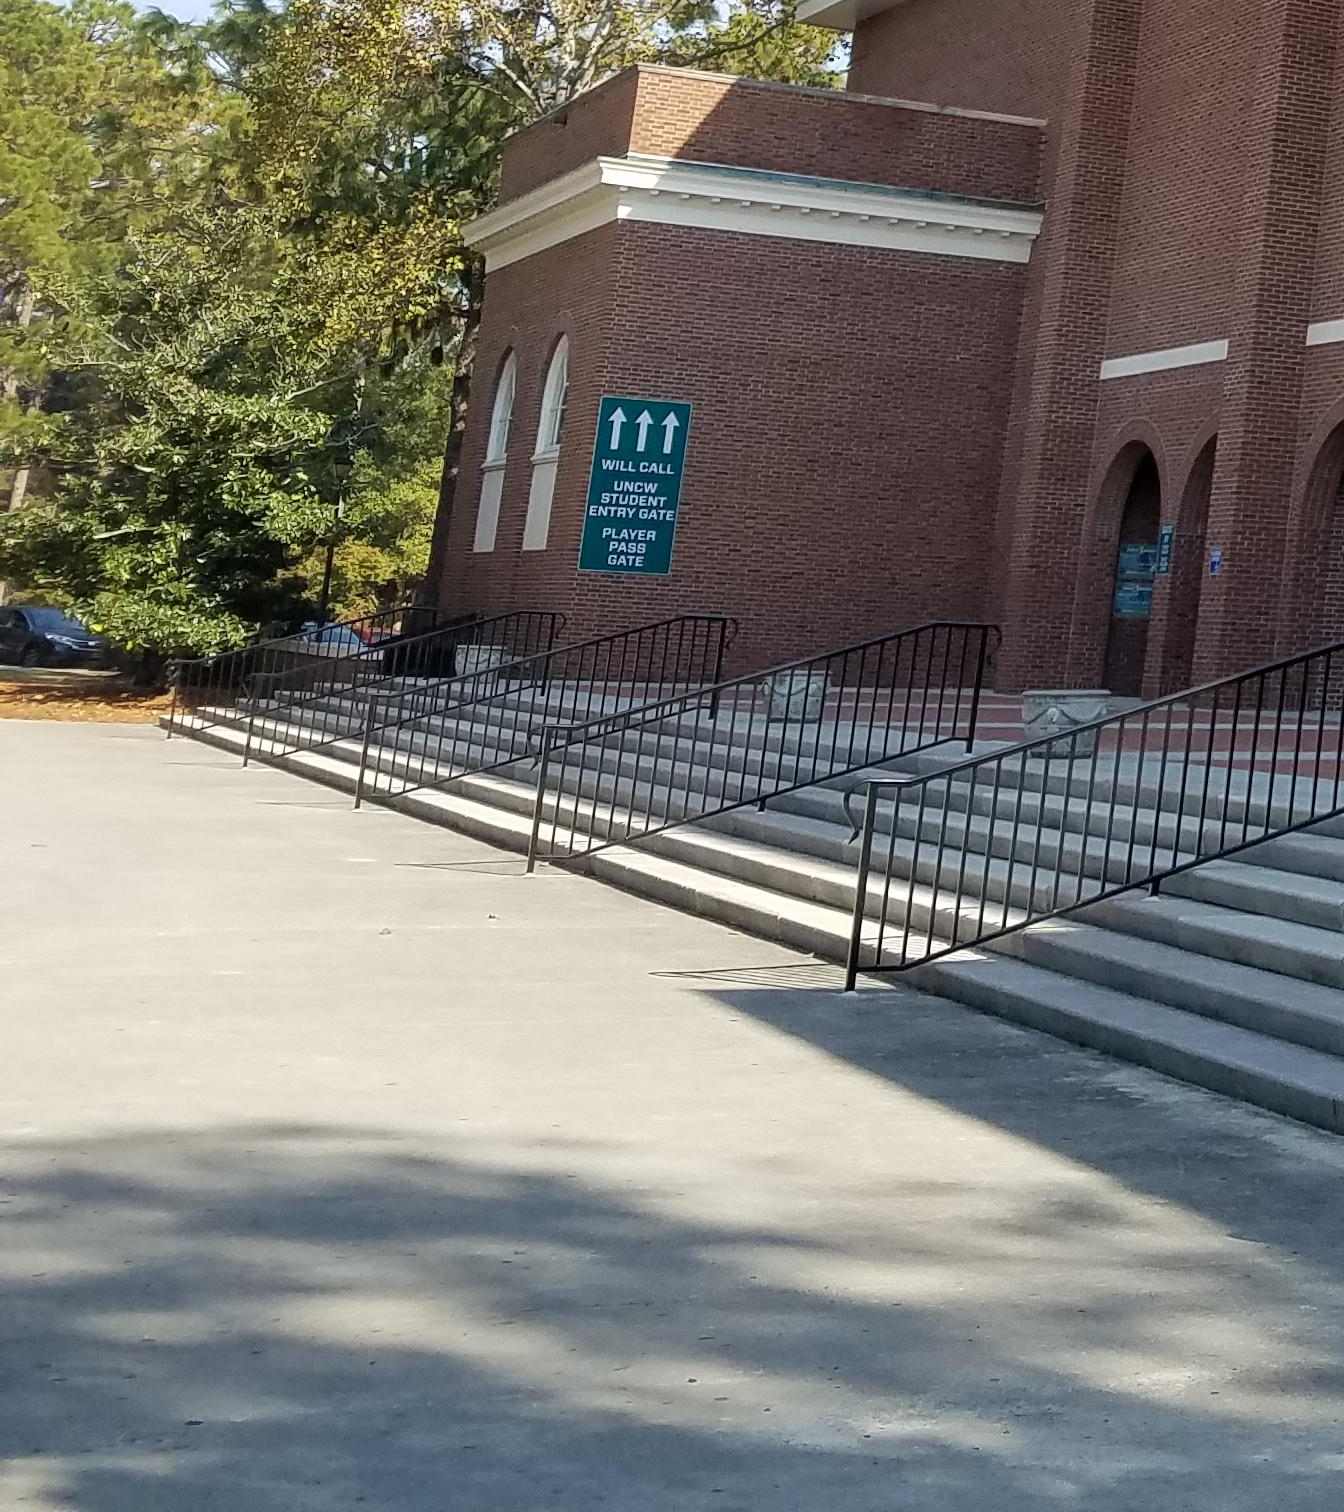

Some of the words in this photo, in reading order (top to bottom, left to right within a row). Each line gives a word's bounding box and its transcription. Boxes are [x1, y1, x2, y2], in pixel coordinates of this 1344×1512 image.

[601, 458, 636, 473] WILL
[639, 461, 675, 475] CALL
[613, 480, 658, 494] UNCW
[600, 492, 667, 508] STUDENT
[588, 505, 637, 519] ENTRY
[638, 508, 675, 521] GATE
[601, 527, 657, 542] PLAYER
[608, 541, 647, 554] PASS
[607, 554, 645, 567] GATE
